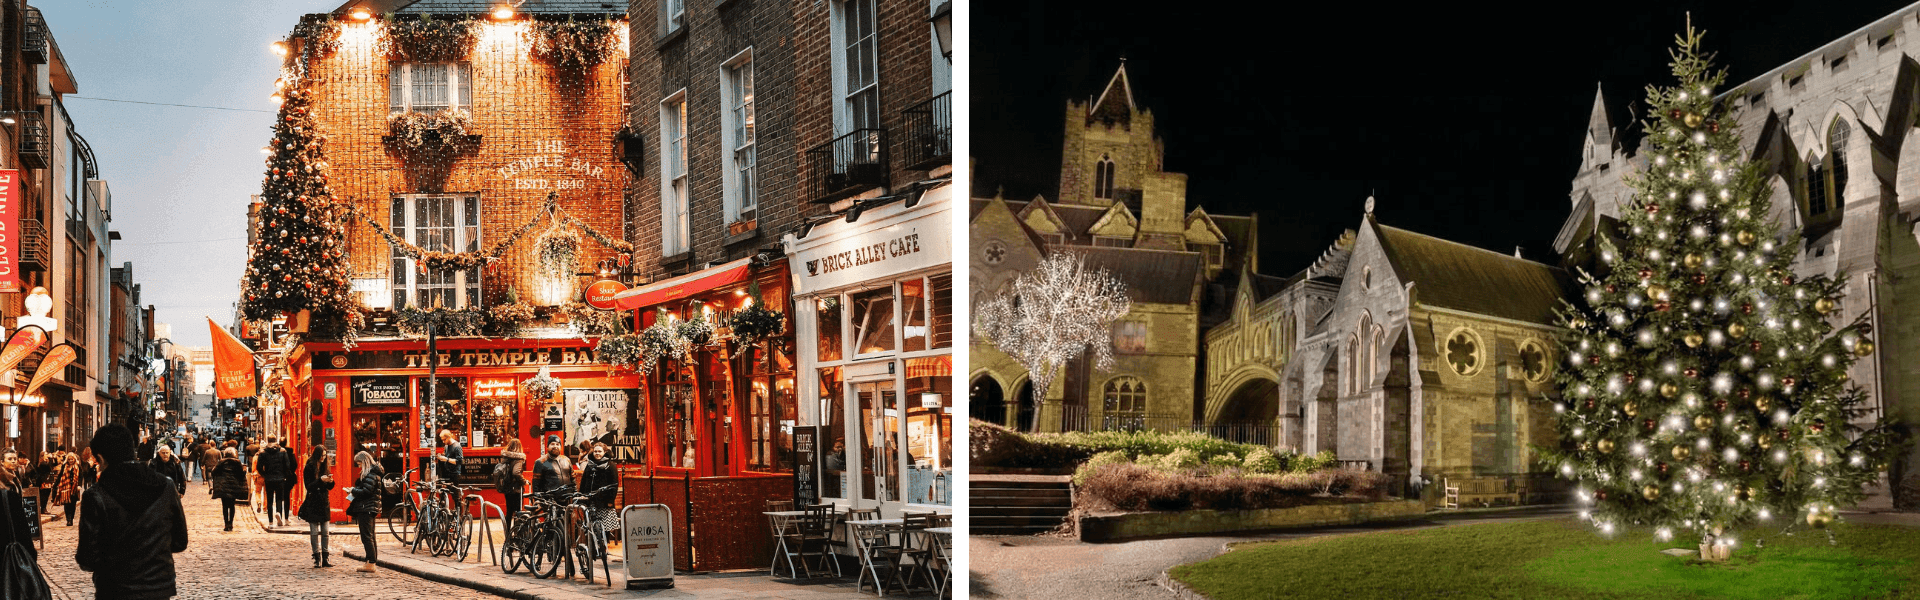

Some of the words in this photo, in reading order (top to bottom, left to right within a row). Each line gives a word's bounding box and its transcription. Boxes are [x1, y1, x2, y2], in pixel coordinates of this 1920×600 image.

[534, 140, 567, 153] THE
[498, 155, 564, 180] TEMPLE
[571, 158, 604, 180] BAR
[556, 179, 584, 190] 1840
[822, 250, 853, 274] BRICK
[855, 242, 887, 266] ALLEY
[889, 227, 920, 258] CAFÉ
[591, 294, 616, 303] Restaur
[334, 357, 345, 365] 48
[403, 353, 452, 368] THE
[461, 352, 551, 366] TEMPLE
[220, 373, 252, 383] TEMPLE
[474, 379, 515, 389] Traditional
[359, 388, 401, 403] TOBACCO
[474, 388, 493, 397] Irish
[495, 388, 517, 397] Music
[585, 393, 626, 401] TEMPLE
[598, 401, 618, 410] BAR
[630, 525, 665, 537] ARIOSA
